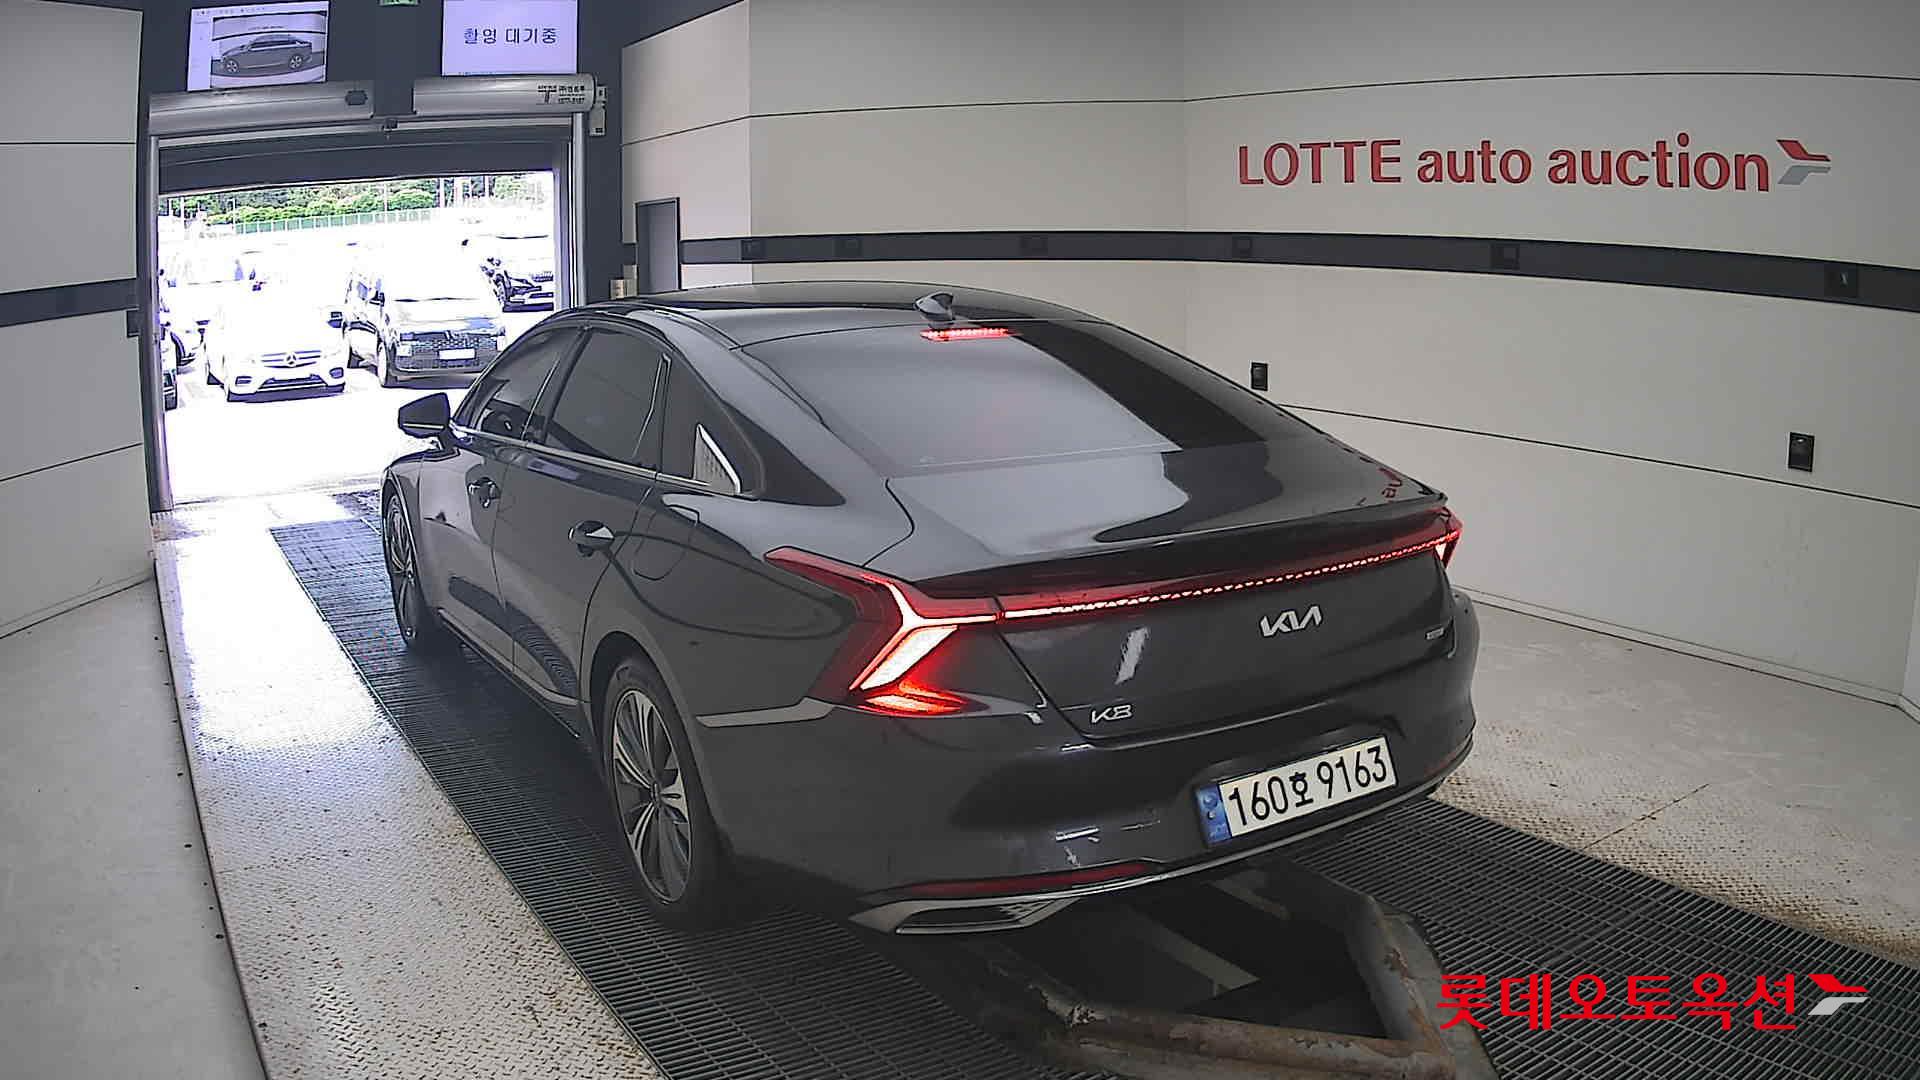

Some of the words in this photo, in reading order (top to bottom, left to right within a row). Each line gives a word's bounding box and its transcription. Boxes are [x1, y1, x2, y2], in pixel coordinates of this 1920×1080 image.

[505, 28, 557, 45] 대기중
[1239, 139, 1402, 186] LOTTE
[1416, 139, 1532, 185] auto
[1547, 132, 1771, 193] auction
[1260, 606, 1322, 638] KIA
[1091, 704, 1133, 725] K8
[1228, 771, 1315, 826] 160호
[1316, 745, 1388, 800] 9163
